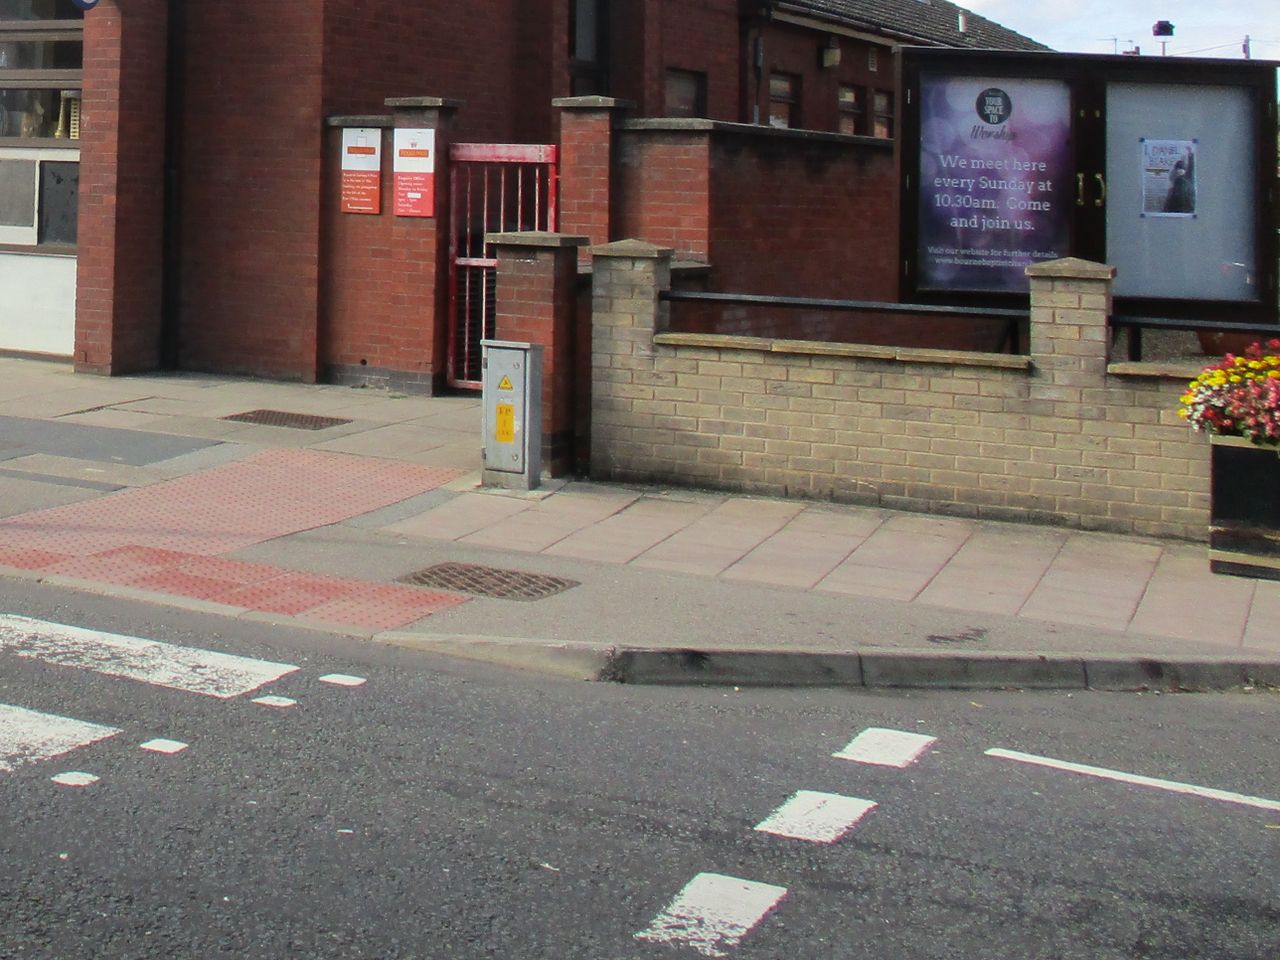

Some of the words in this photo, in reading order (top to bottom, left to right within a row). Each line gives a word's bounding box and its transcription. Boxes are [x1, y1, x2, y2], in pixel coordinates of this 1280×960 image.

[984, 96, 1002, 106] YOUR
[983, 105, 1004, 115] SPACE
[989, 114, 999, 124] TO
[939, 155, 966, 168] We
[970, 158, 1009, 170] meet
[1013, 158, 1047, 171] here
[934, 178, 976, 192] every
[979, 176, 1035, 194] Sunday
[1038, 180, 1053, 192] at
[934, 194, 999, 209] 10.30am.
[1006, 197, 1051, 211] Come
[950, 215, 978, 228] and
[981, 215, 1010, 231] join
[1014, 219, 1036, 230] us.
[960, 248, 990, 256] website
[990, 248, 1002, 257] for
[1003, 249, 1030, 257] further
